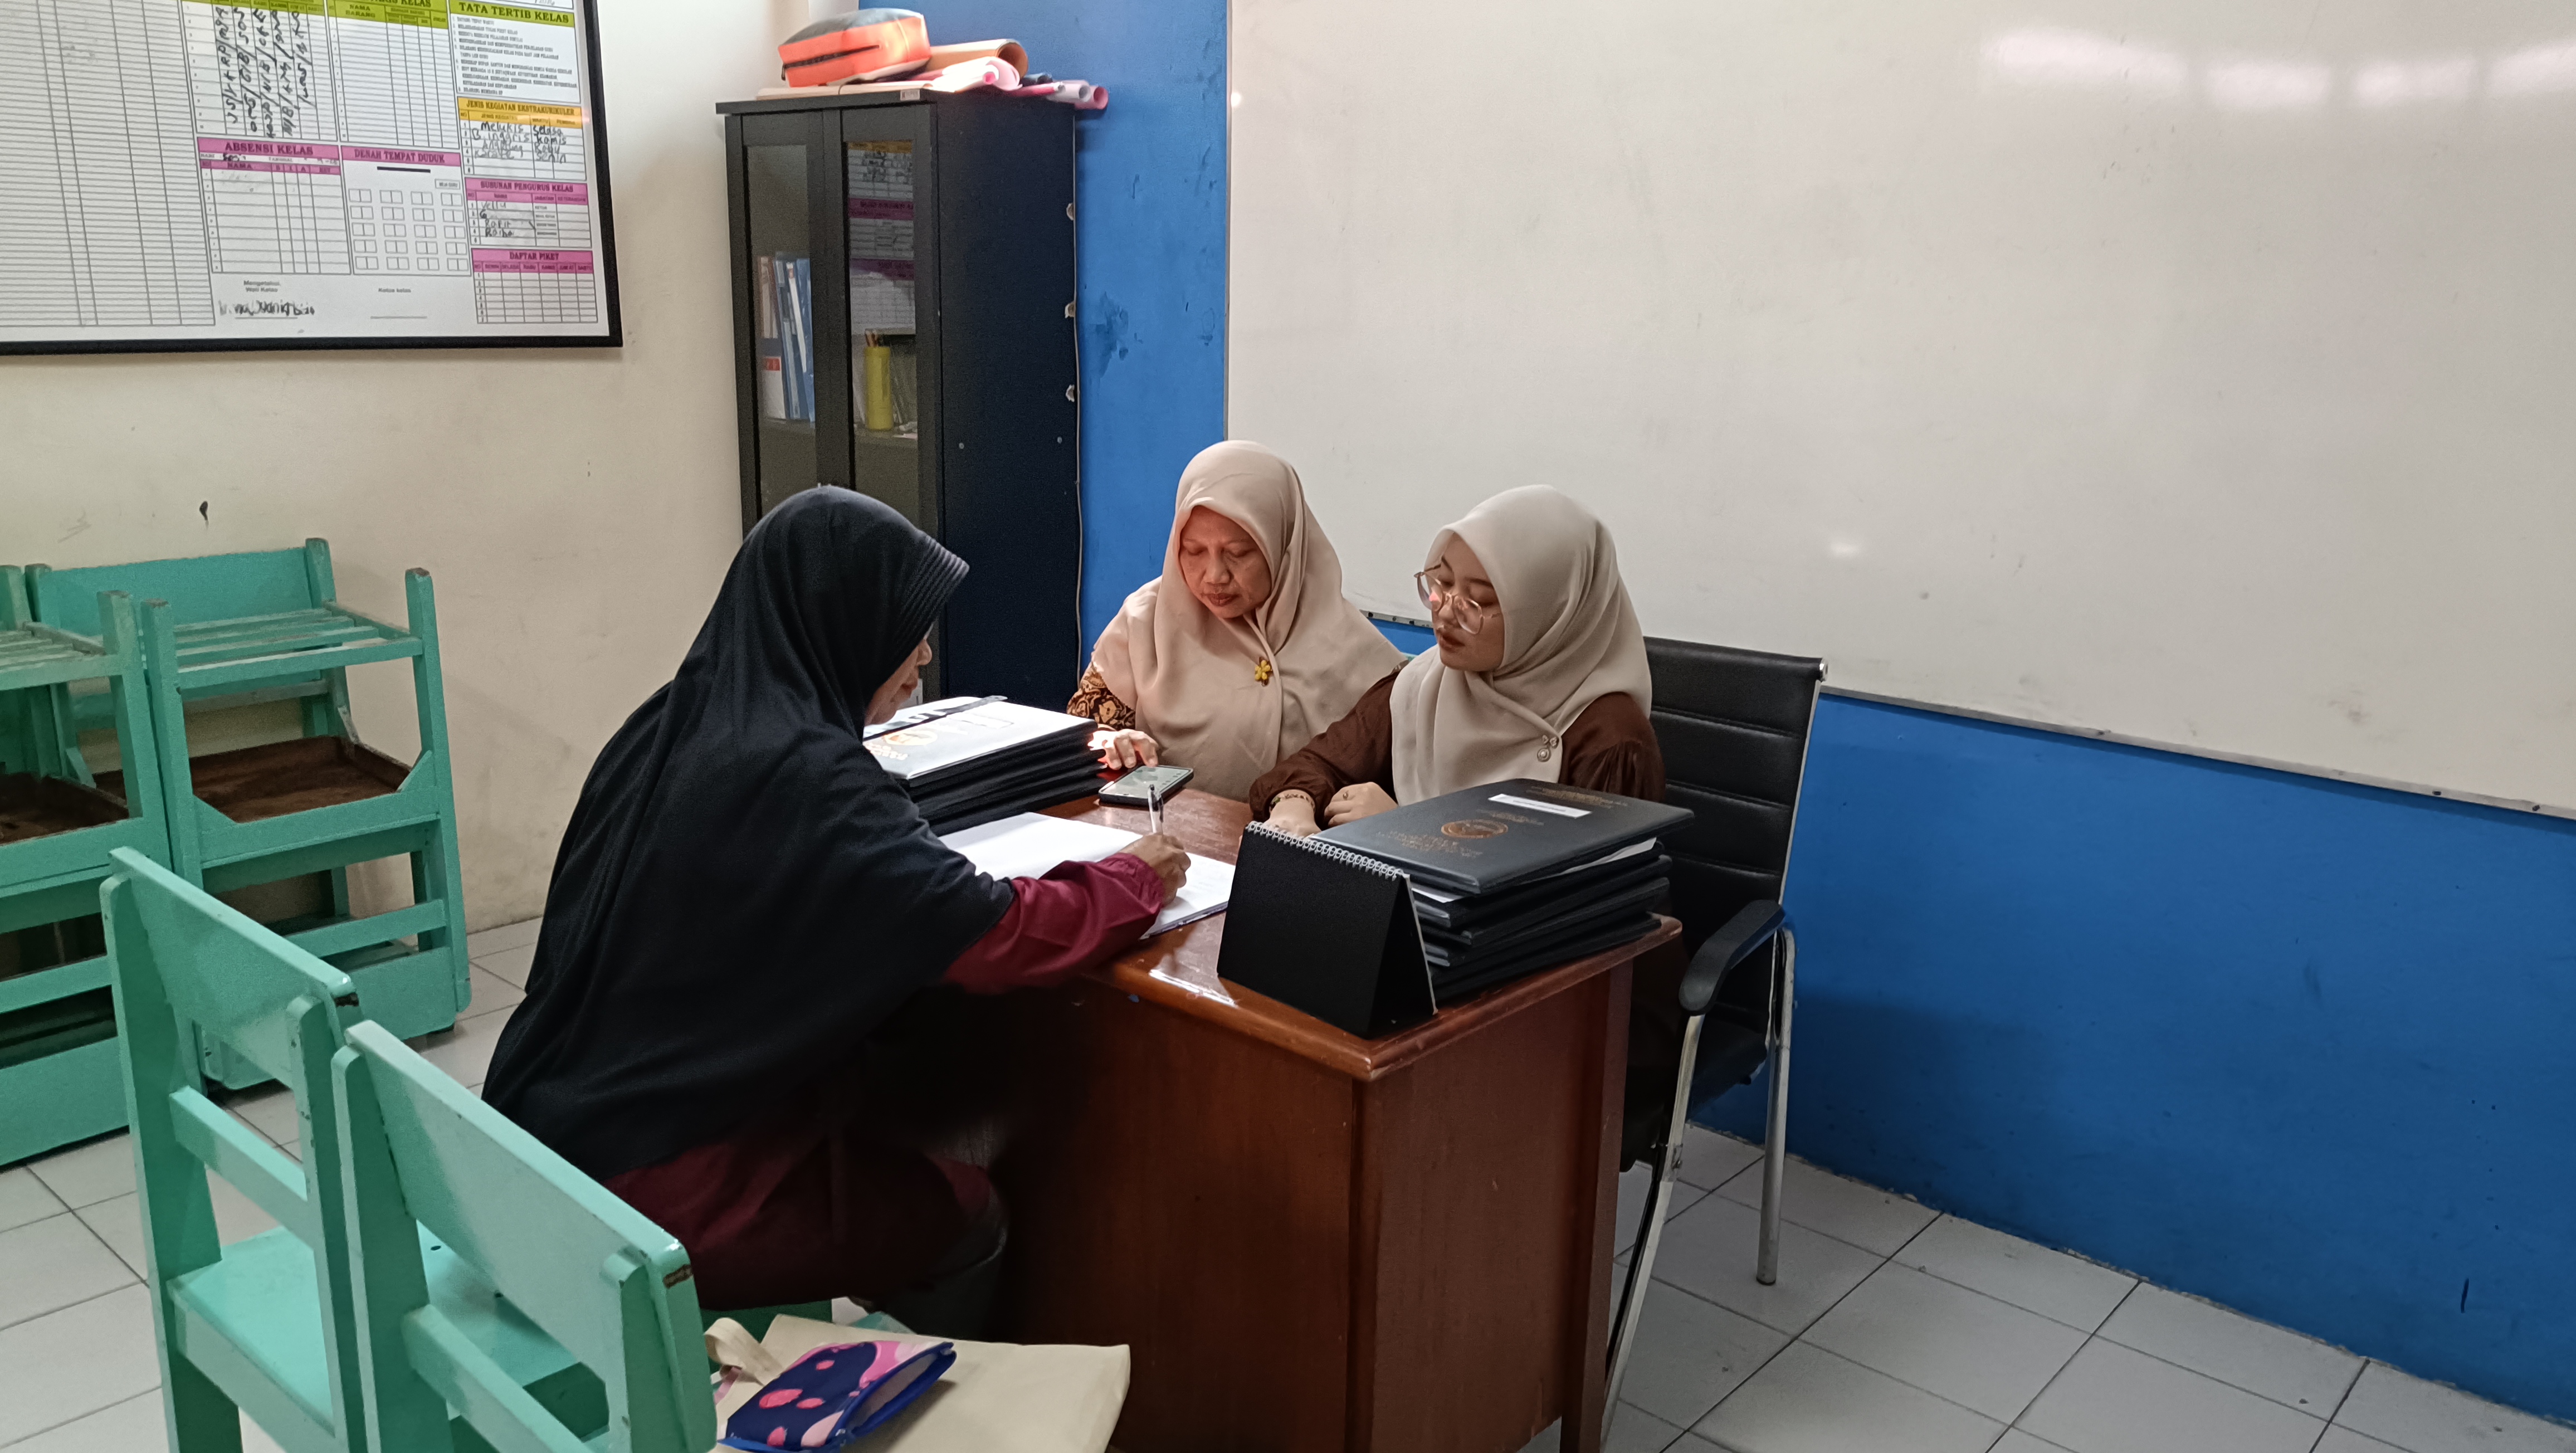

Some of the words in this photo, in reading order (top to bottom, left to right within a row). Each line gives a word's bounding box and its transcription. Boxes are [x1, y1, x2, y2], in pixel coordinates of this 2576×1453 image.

[458, 2, 489, 14] TATA
[491, 6, 531, 19] TERTIB
[534, 11, 569, 23] KELAS
[466, 100, 484, 108] JENIS
[486, 101, 516, 111] KEGIATAN
[517, 104, 575, 115] EKSTRAKURIKULER
[225, 142, 273, 154] ABSENSI
[277, 145, 313, 155] KELAS
[354, 149, 381, 159] DENAH
[384, 151, 416, 162] TEMPAT
[418, 153, 445, 163] DUDUK
[480, 181, 512, 190] SUSUNAN
[514, 182, 550, 191] PENGURUS
[552, 183, 574, 192] KELAS
[509, 252, 537, 260] DAFTAR
[539, 252, 559, 261] PIKET
